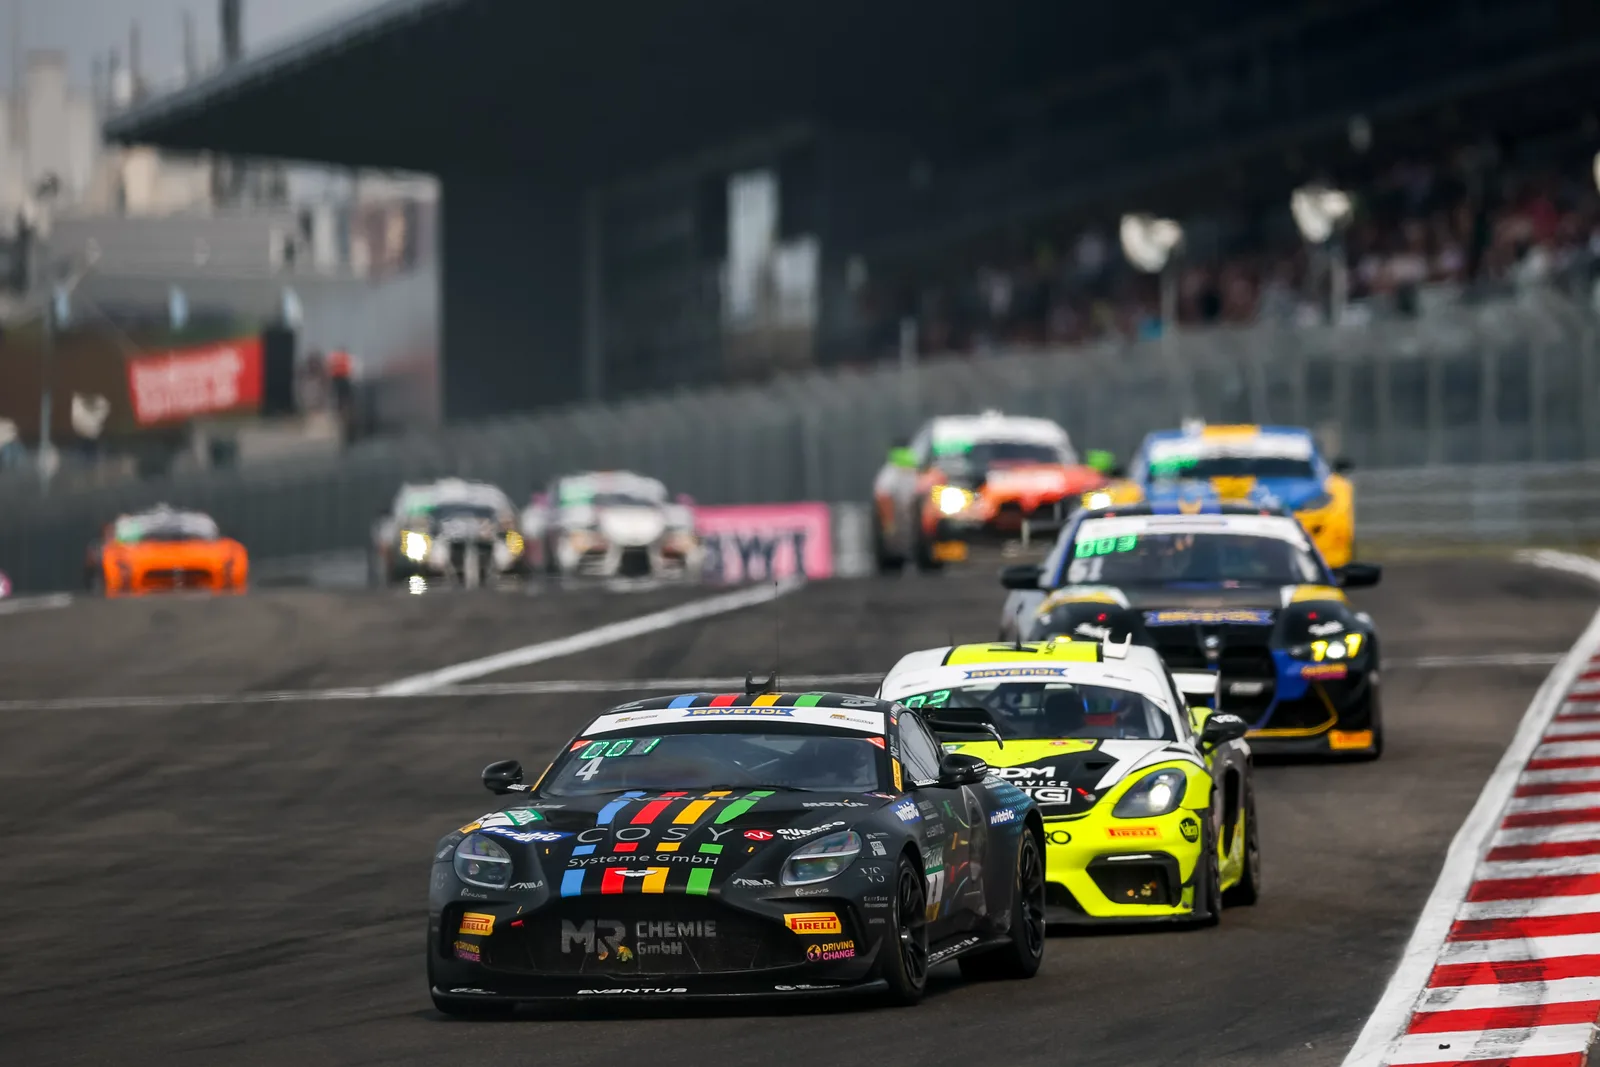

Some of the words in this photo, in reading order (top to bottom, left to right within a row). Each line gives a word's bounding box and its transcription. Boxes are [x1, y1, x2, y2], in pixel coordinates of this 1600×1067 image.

[1076, 535, 1136, 558] 003
[970, 669, 1061, 678] RAVENOL
[692, 707, 789, 716] RAVENOL
[579, 737, 662, 760] 001
[574, 756, 604, 781] 4
[576, 827, 734, 843] COSY
[567, 854, 650, 867] Systeme
[655, 853, 719, 866] GmbH
[461, 916, 489, 932] PIRELLI
[636, 920, 717, 938] CHEMIE
[790, 916, 837, 930] PIRELLI
[561, 919, 627, 954] MR
[636, 942, 683, 955] GmbH
[822, 940, 855, 952] DRIVING
[822, 949, 855, 961] CHANGE
